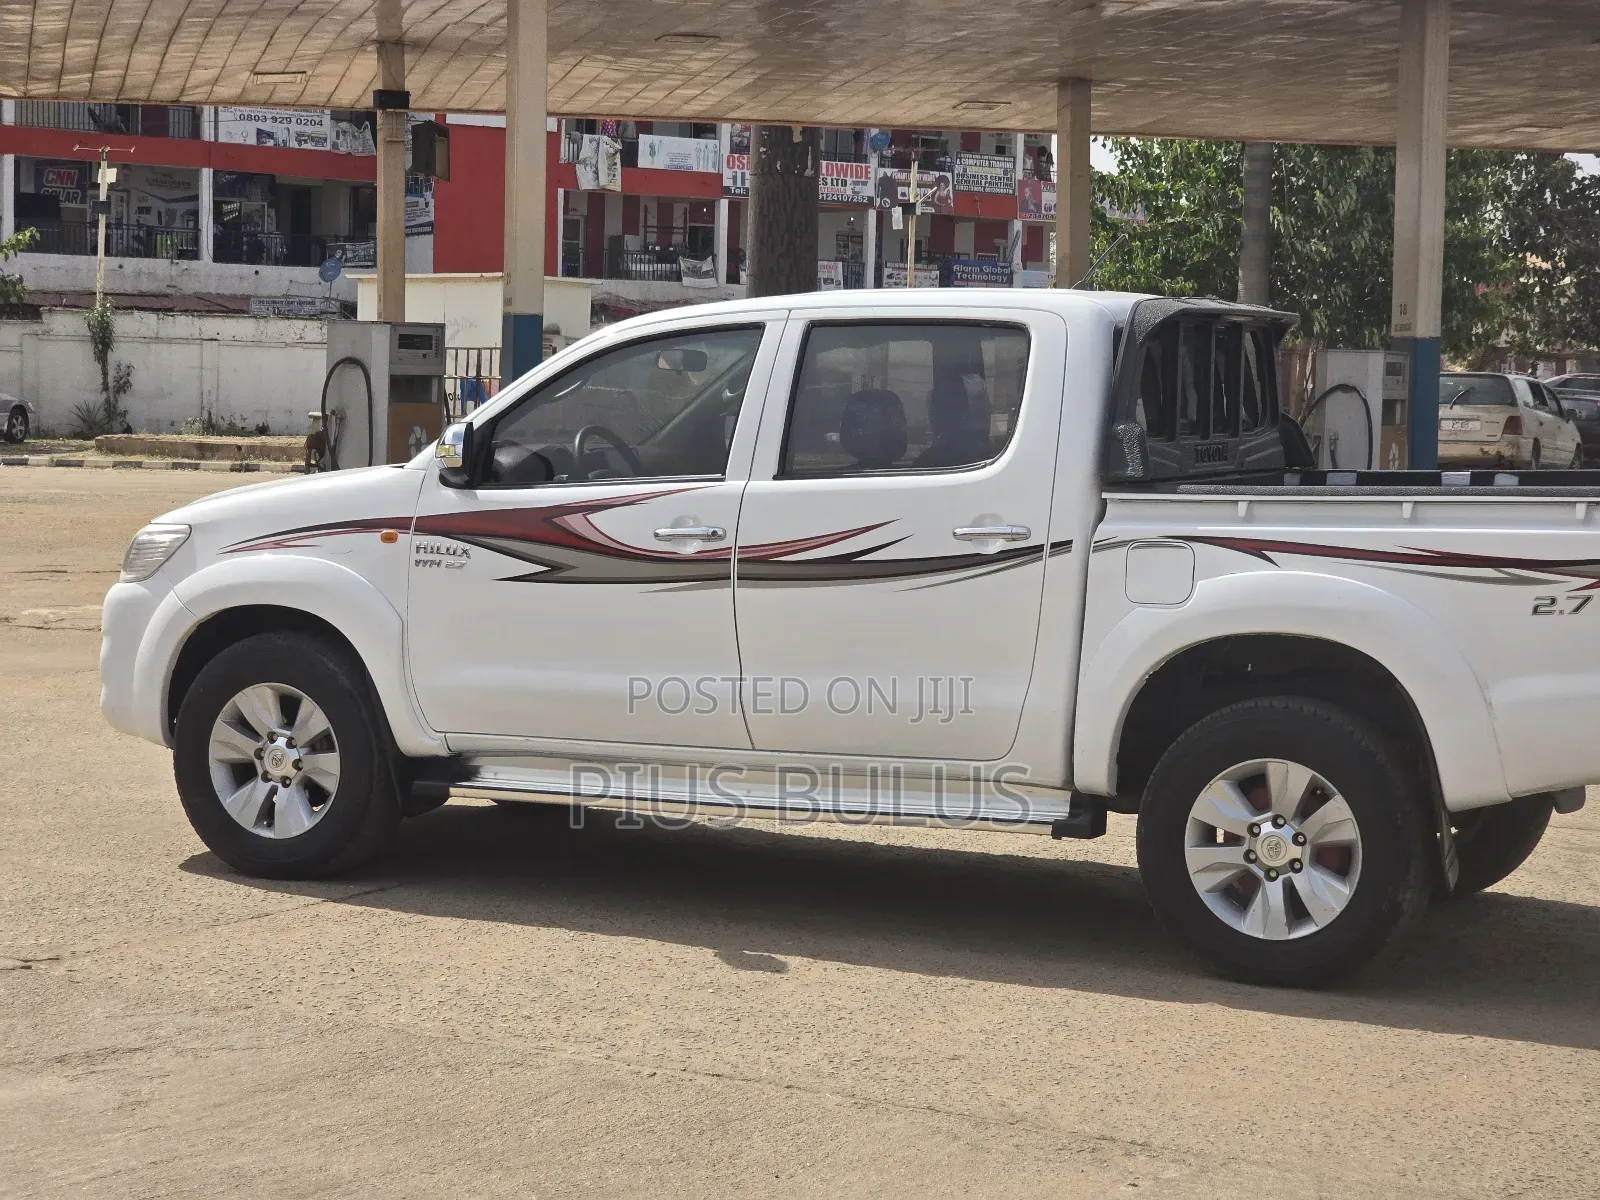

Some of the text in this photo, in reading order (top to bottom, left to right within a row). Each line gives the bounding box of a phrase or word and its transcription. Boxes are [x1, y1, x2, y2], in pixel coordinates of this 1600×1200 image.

[239, 113, 323, 127] 0803 929 0204
[961, 158, 990, 167] COMPUTER
[990, 160, 1014, 169] TRAINING
[44, 169, 78, 187] CNN
[830, 177, 848, 188] LTD
[955, 172, 1014, 184] BUSINESS CENTRE
[955, 178, 984, 187] GENERAL
[984, 181, 1014, 190] PRINTING
[730, 186, 746, 195] Tel:
[953, 264, 1011, 275] Alarm Global
[955, 272, 1008, 283] Technology
[415, 541, 471, 560] HILUX
[1531, 594, 1594, 616] 2.7
